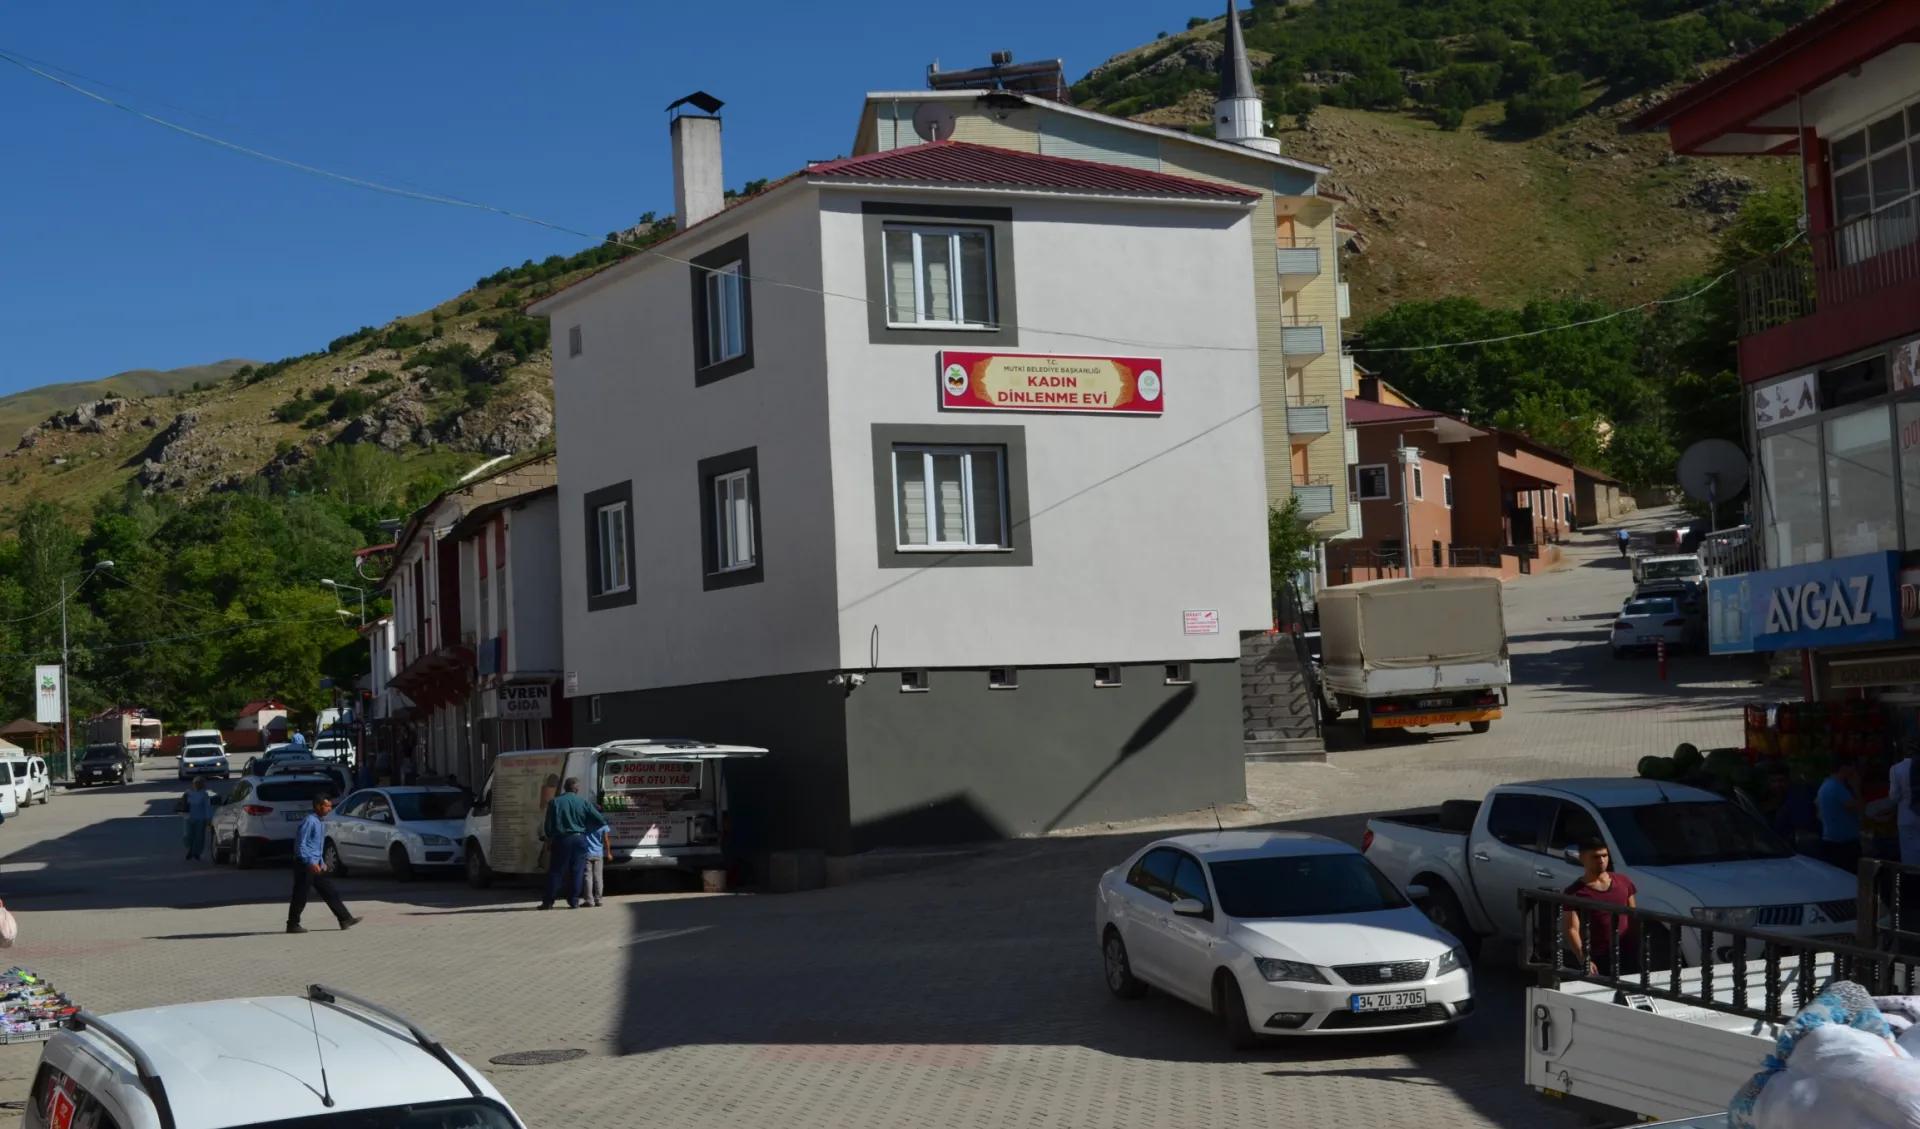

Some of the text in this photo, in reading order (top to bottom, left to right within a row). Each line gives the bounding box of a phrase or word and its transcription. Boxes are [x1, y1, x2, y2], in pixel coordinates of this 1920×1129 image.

[1060, 367, 1101, 375] BAŞKANLIĞI
[1027, 376, 1077, 388] KADIN
[998, 389, 1108, 405] DİNLENME EVİ
[1765, 575, 1873, 634] AYGAZ
[500, 686, 548, 699] EVREN
[507, 699, 540, 711] GIDA
[658, 763, 681, 773] PRES
[646, 775, 666, 785] OTU
[1359, 996, 1373, 1008] 34
[1378, 995, 1391, 1007] ZU
[1396, 992, 1422, 1006] 3705
